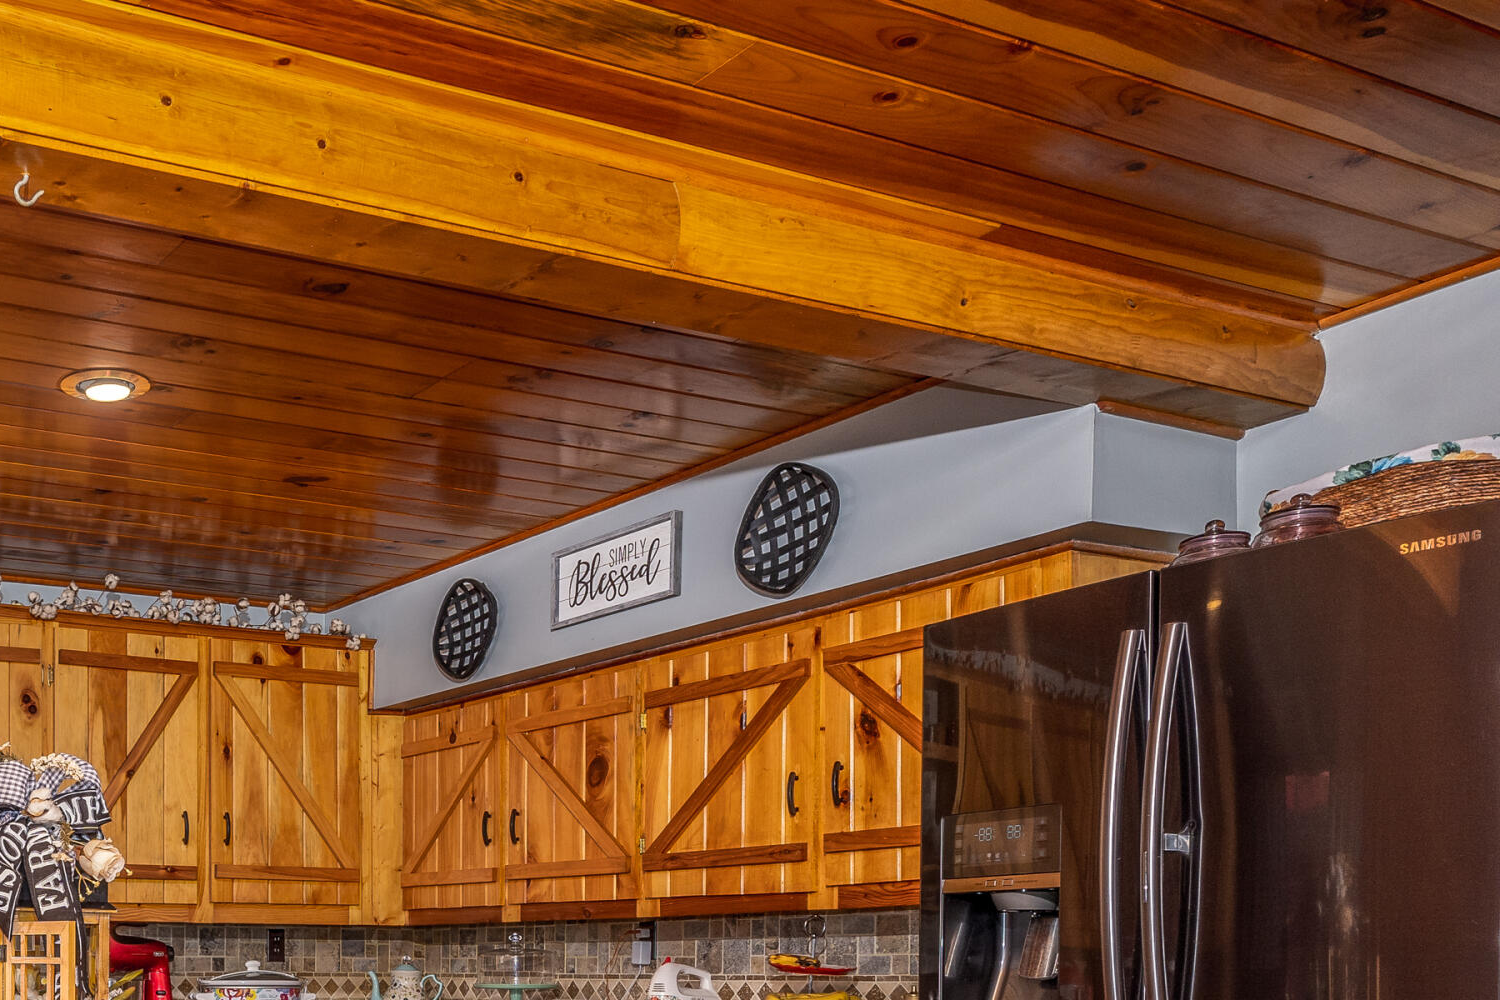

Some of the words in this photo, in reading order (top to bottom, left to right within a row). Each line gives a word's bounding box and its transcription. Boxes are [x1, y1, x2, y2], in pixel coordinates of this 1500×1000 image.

[609, 537, 647, 567] SIMPLY
[1399, 529, 1482, 555] SAMSUNG
[569, 538, 661, 607] Blessed
